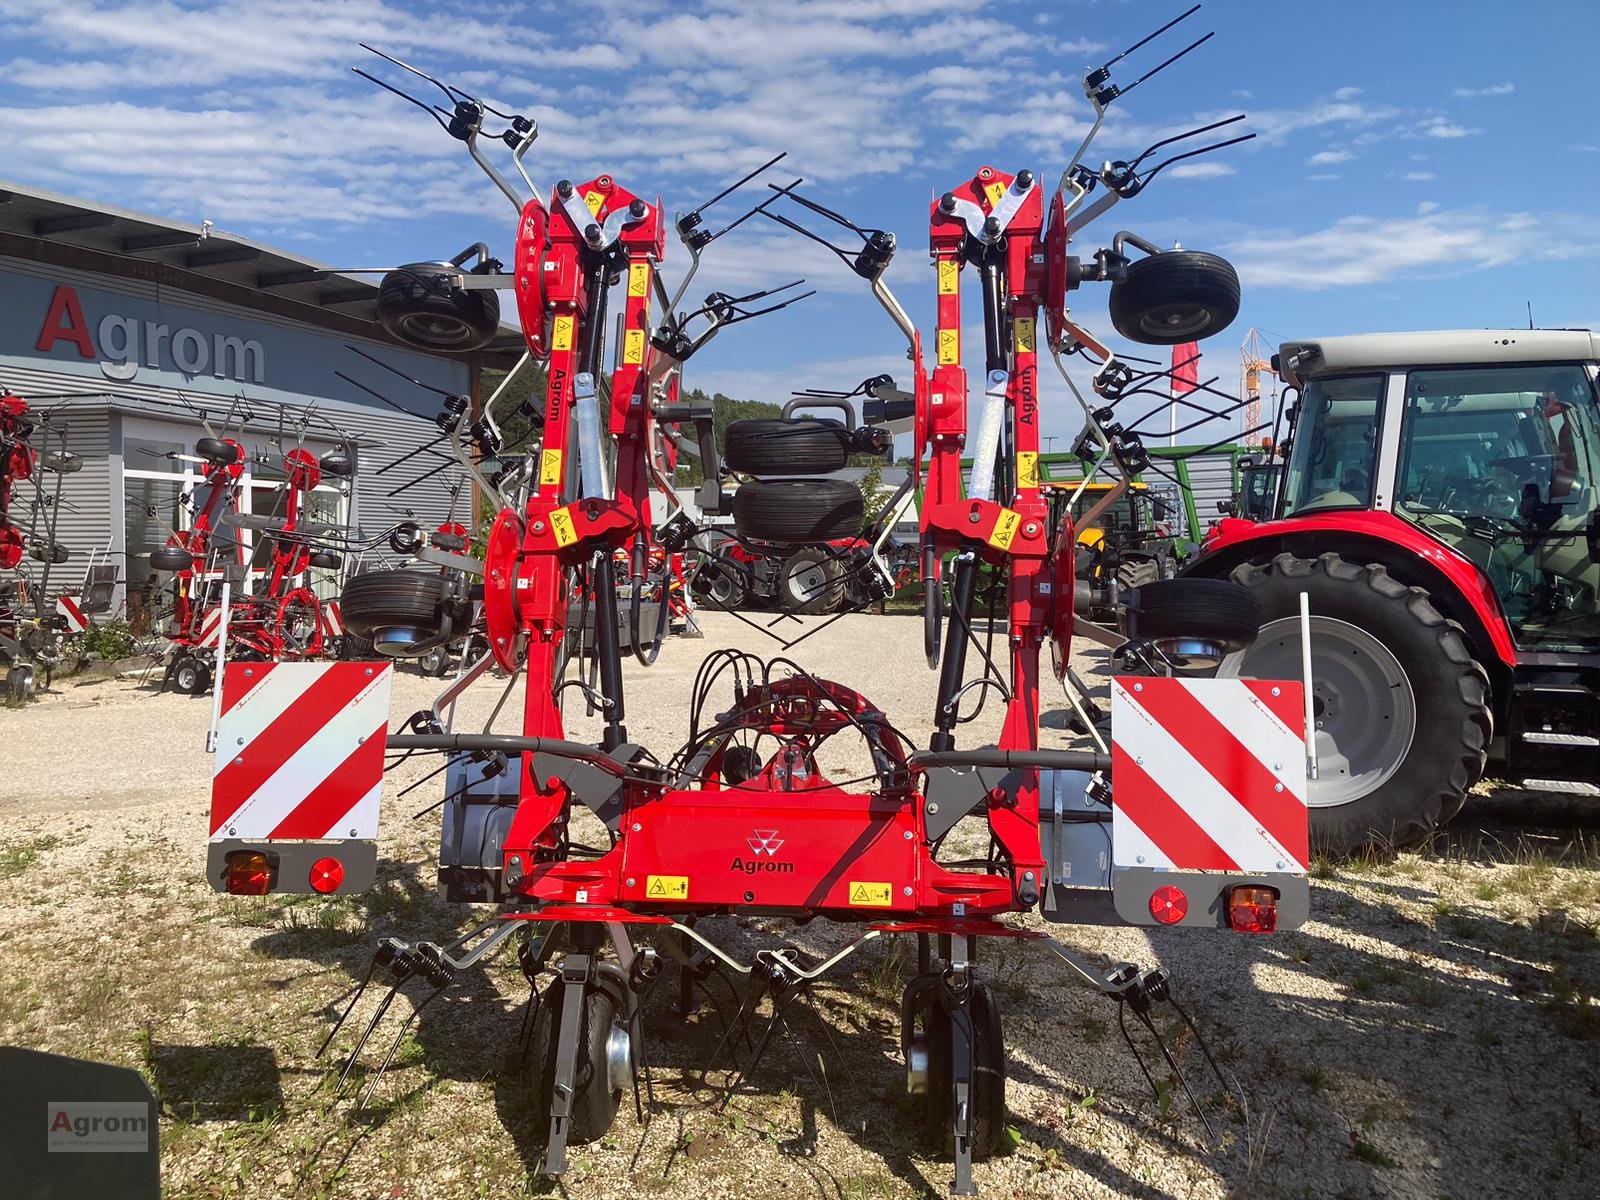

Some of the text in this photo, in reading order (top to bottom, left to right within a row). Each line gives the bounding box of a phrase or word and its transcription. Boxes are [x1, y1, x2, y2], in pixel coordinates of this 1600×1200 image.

[35, 284, 265, 380] Agrom
[550, 368, 567, 422] Agrom
[1020, 371, 1035, 425] Agrom
[730, 857, 794, 875] Agrom
